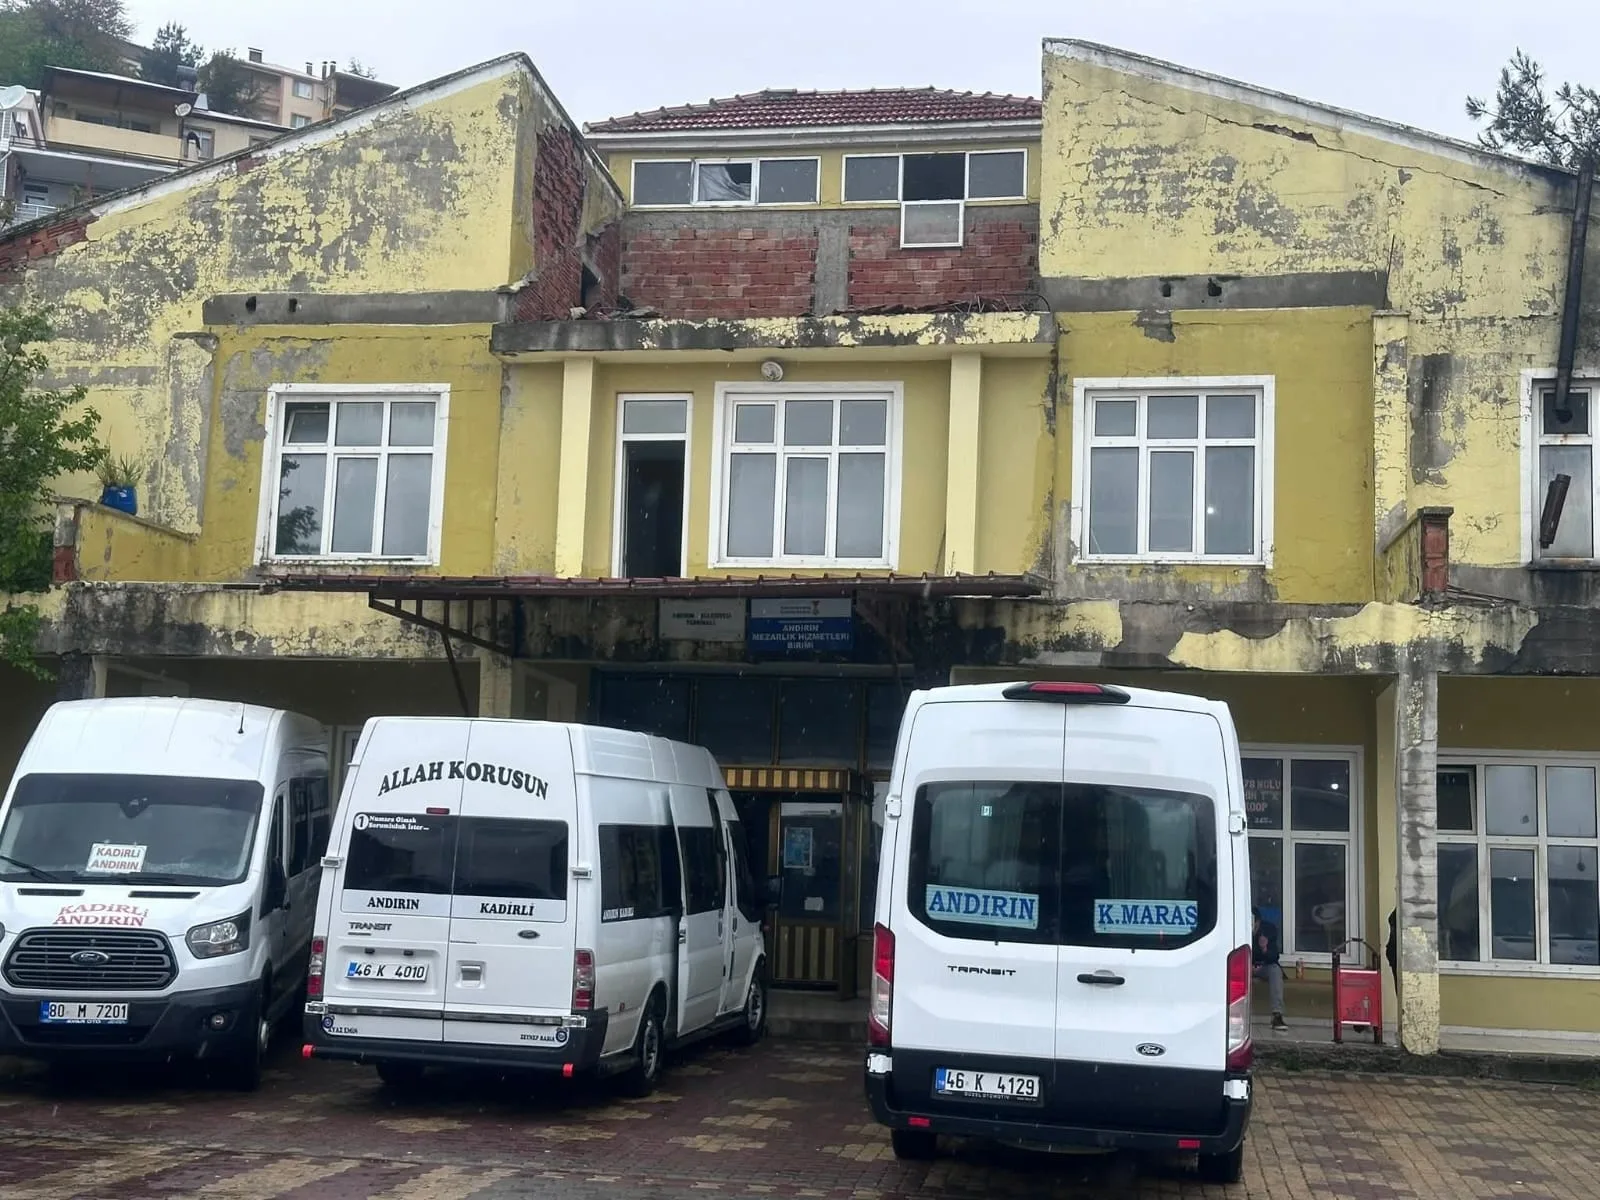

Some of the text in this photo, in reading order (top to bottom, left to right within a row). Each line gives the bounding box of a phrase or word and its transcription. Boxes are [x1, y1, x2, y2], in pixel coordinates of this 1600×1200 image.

[752, 632, 797, 641] MEZARLIK
[378, 761, 549, 801] ALLAH KORUSUN
[395, 816, 417, 824] Olmak
[90, 859, 140, 870] ANDIRIN
[367, 896, 535, 916] ANDIRIN KADİRLİ
[929, 889, 1035, 920] ANDIRIN
[53, 915, 145, 927] ANDIRIN
[348, 921, 393, 932] TRANSIT
[355, 961, 426, 979] 46 K 4010
[947, 965, 1017, 977] TRANSIT
[49, 1004, 127, 1019] 80 M 7201
[946, 1070, 1036, 1096] 46 K 4129
